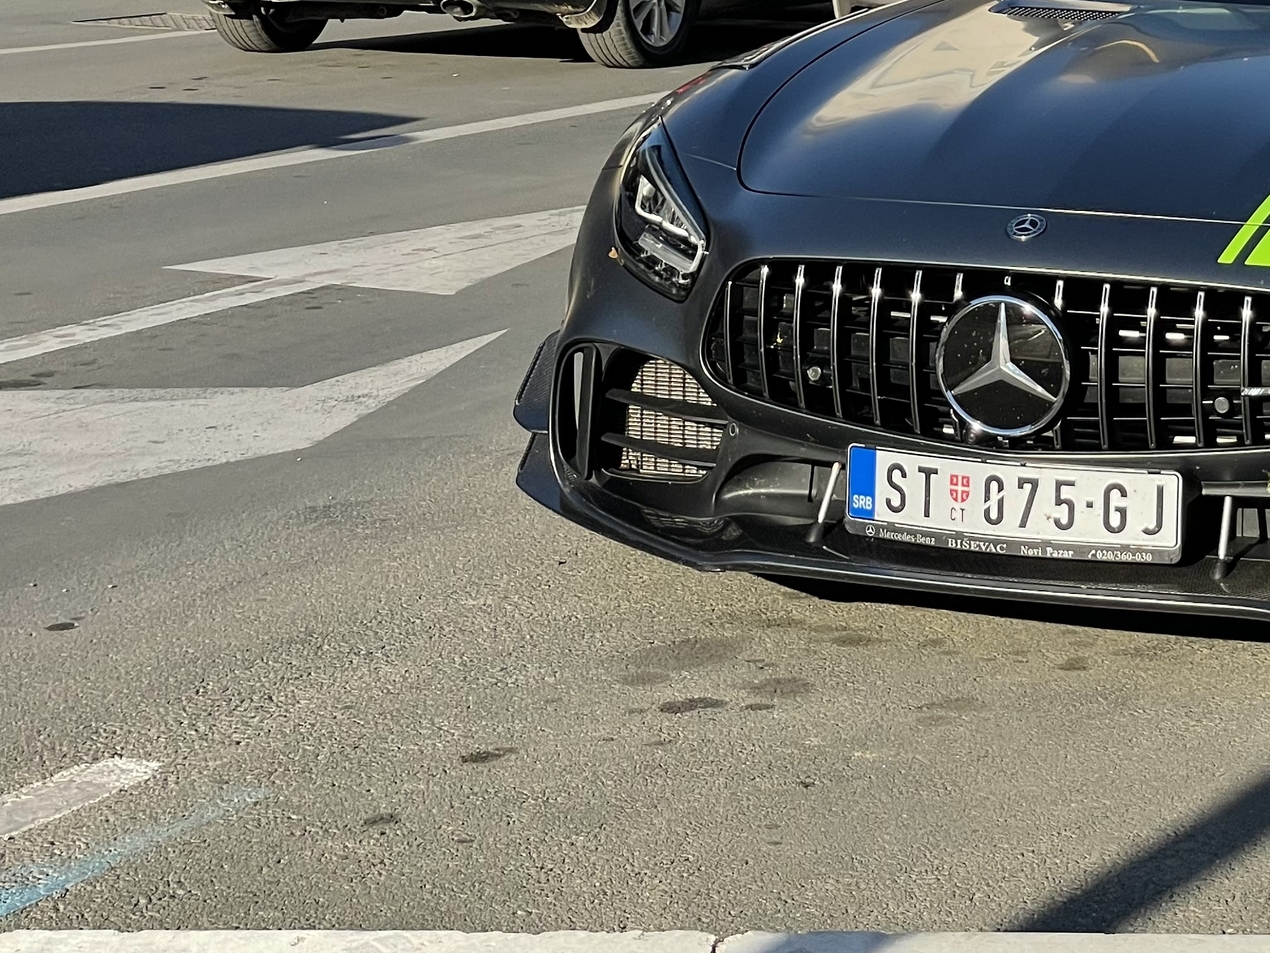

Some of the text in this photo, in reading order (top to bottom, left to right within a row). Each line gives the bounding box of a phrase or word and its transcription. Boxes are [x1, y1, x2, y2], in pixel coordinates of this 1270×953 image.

[852, 494, 873, 510] SRB
[885, 462, 939, 518] ST
[879, 528, 1153, 562] Mercedes-Benz BIŠEVAC Novi Pazar 020/360-030
